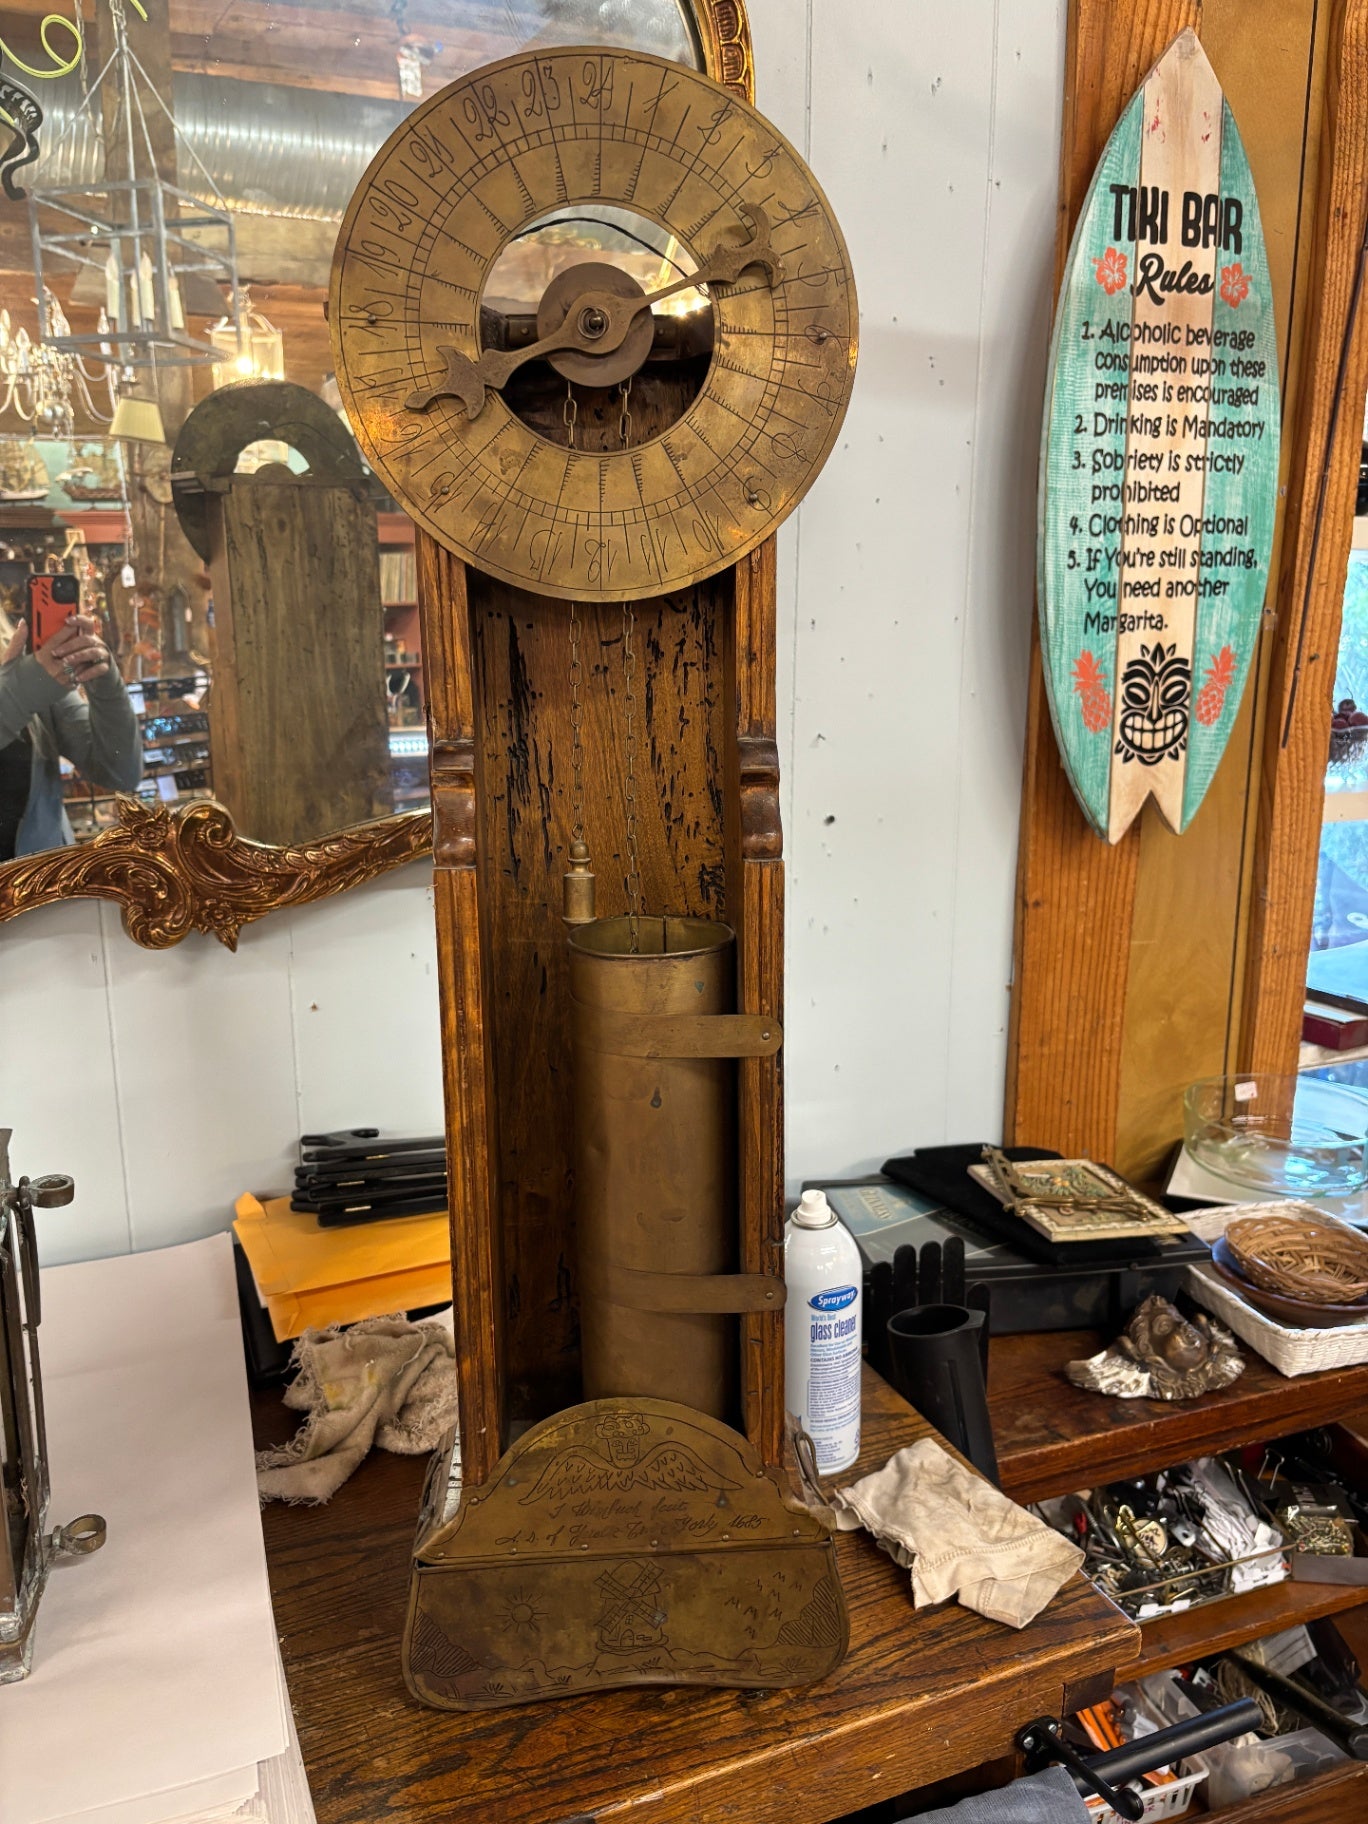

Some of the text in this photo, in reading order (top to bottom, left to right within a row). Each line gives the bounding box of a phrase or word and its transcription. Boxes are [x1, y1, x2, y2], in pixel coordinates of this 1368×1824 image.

[521, 65, 561, 117] 23
[580, 61, 614, 110] 24
[462, 85, 511, 141] 22
[409, 125, 455, 178] 21
[369, 180, 419, 232] 20
[1109, 184, 1243, 254] TIKI BAR
[351, 240, 401, 279] 19
[1130, 252, 1215, 306] Rules
[348, 301, 398, 338] 18
[1081, 319, 1255, 350] 1. Alcoholic beverage
[1095, 351, 1266, 377] consumption upon these
[1095, 381, 1259, 408] premises is encouraged
[1073, 412, 1265, 440] 2. Drinking is Mandatory
[1071, 448, 1245, 475] 3. Sobriety is strictly
[1091, 481, 1181, 504] prohibited
[1069, 513, 1248, 538] 4. Clothing is Optional
[1067, 547, 1258, 571] 5. If You're still standing,
[1084, 578, 1230, 603] You need another
[1083, 610, 1168, 636] Margarita.
[817, 1289, 855, 1308] Sprayway
[811, 1314, 857, 1343] glass cleaner
